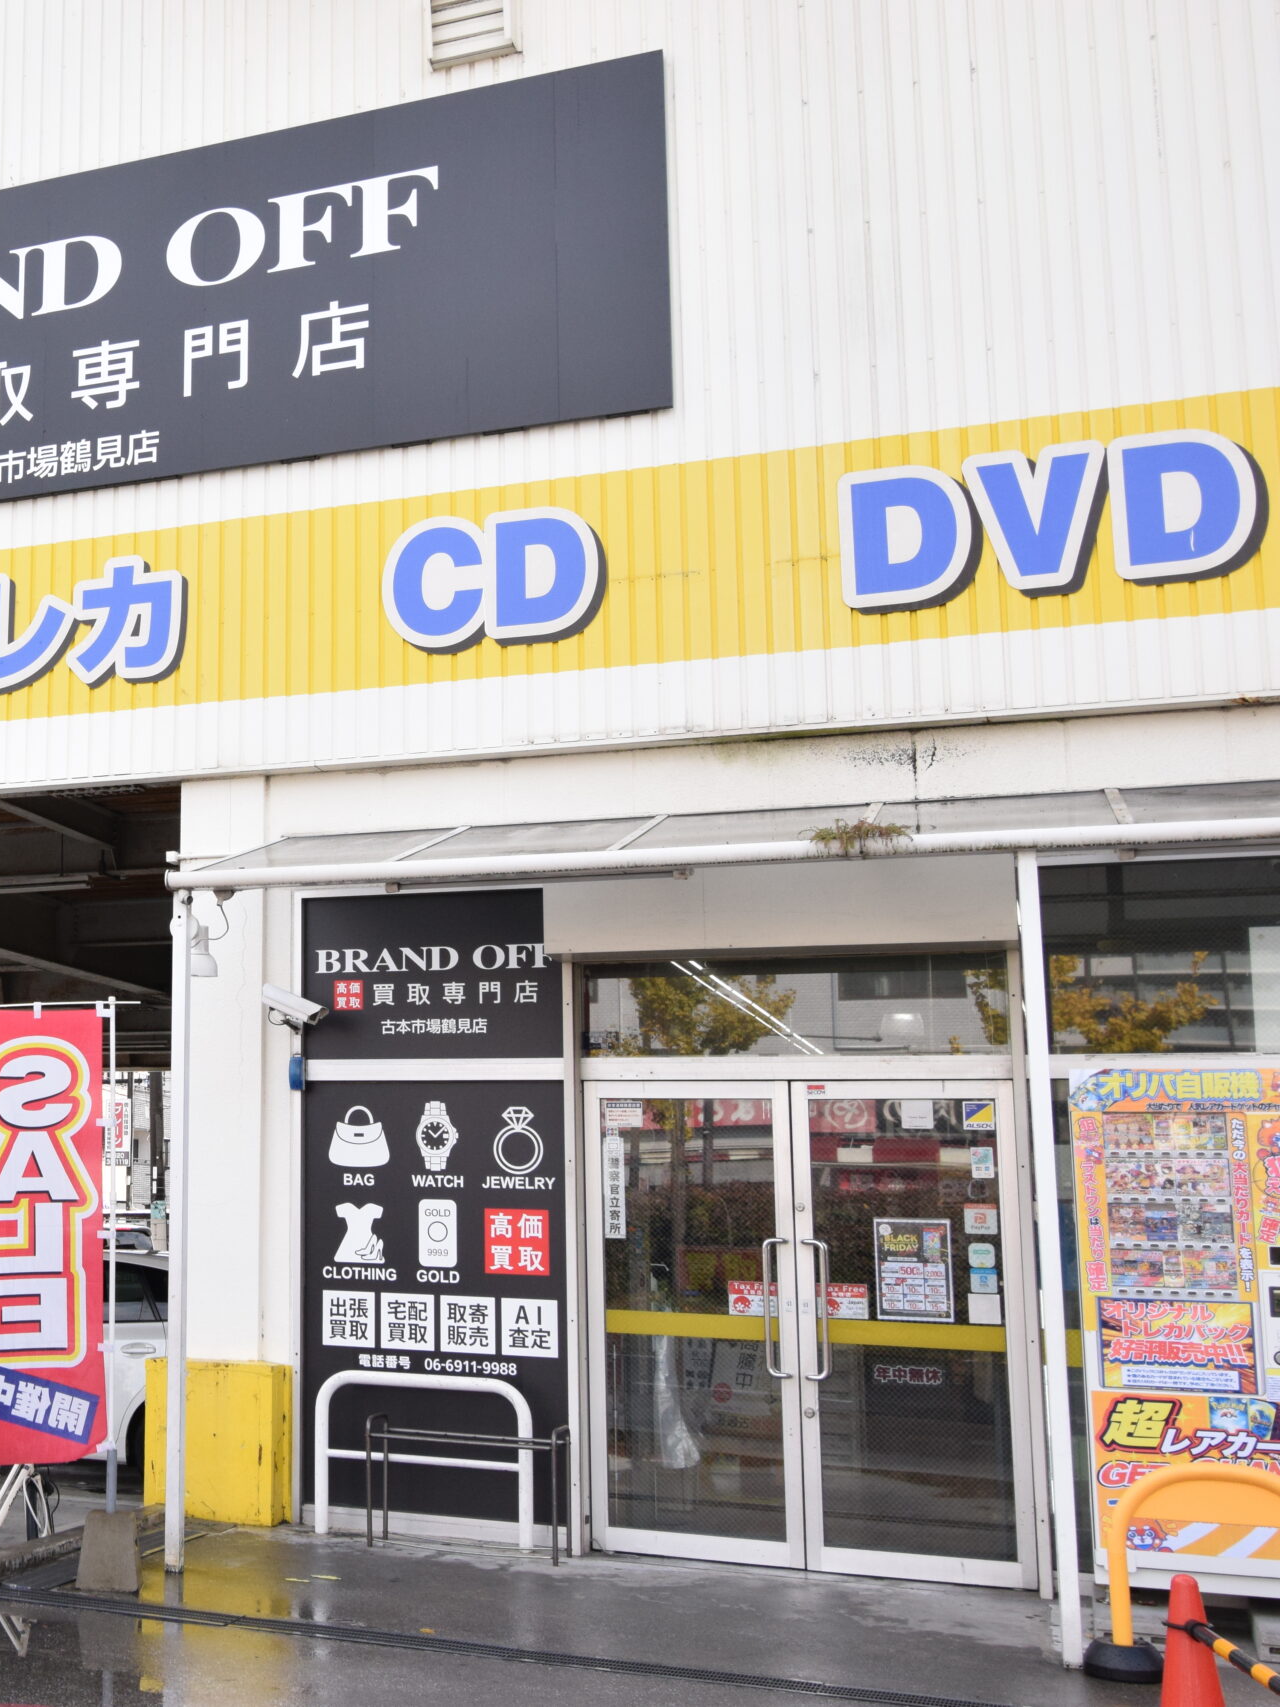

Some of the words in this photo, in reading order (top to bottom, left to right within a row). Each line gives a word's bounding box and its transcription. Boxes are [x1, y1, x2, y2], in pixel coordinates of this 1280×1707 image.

[166, 166, 439, 287] OFF
[837, 430, 1269, 612] DVD
[382, 505, 606, 652] CD
[315, 946, 460, 974] BRAND
[336, 982, 361, 994] 高価
[372, 980, 539, 1006] 買取専門店
[336, 996, 361, 1008] 買取
[381, 1018, 488, 1035] 古本市場鶴見店
[1099, 1070, 1261, 1100] オリパ自販機
[343, 1173, 375, 1187] BAG
[411, 1175, 464, 1188] WATCH
[482, 1176, 556, 1190] JEWELRY
[424, 1208, 451, 1217] GOLD
[489, 1212, 543, 1240] 高価
[489, 1245, 544, 1272] 買取
[322, 1266, 397, 1282] CLOTHING
[416, 1270, 460, 1284] GOLD
[754, 1283, 776, 1291] Fre
[329, 1298, 369, 1319] 出張
[387, 1300, 428, 1322] 宅配
[447, 1303, 489, 1324] 取寄
[1102, 1301, 1215, 1322] オリジナル
[329, 1320, 369, 1341] 買取
[388, 1323, 428, 1344] 買取
[447, 1325, 489, 1347] 販売
[508, 1328, 551, 1350] 査定
[358, 1354, 412, 1370] 電話番号
[423, 1358, 518, 1375] 06-6911-9988
[874, 1365, 943, 1385] 年中無休
[1102, 1397, 1175, 1449] 超
